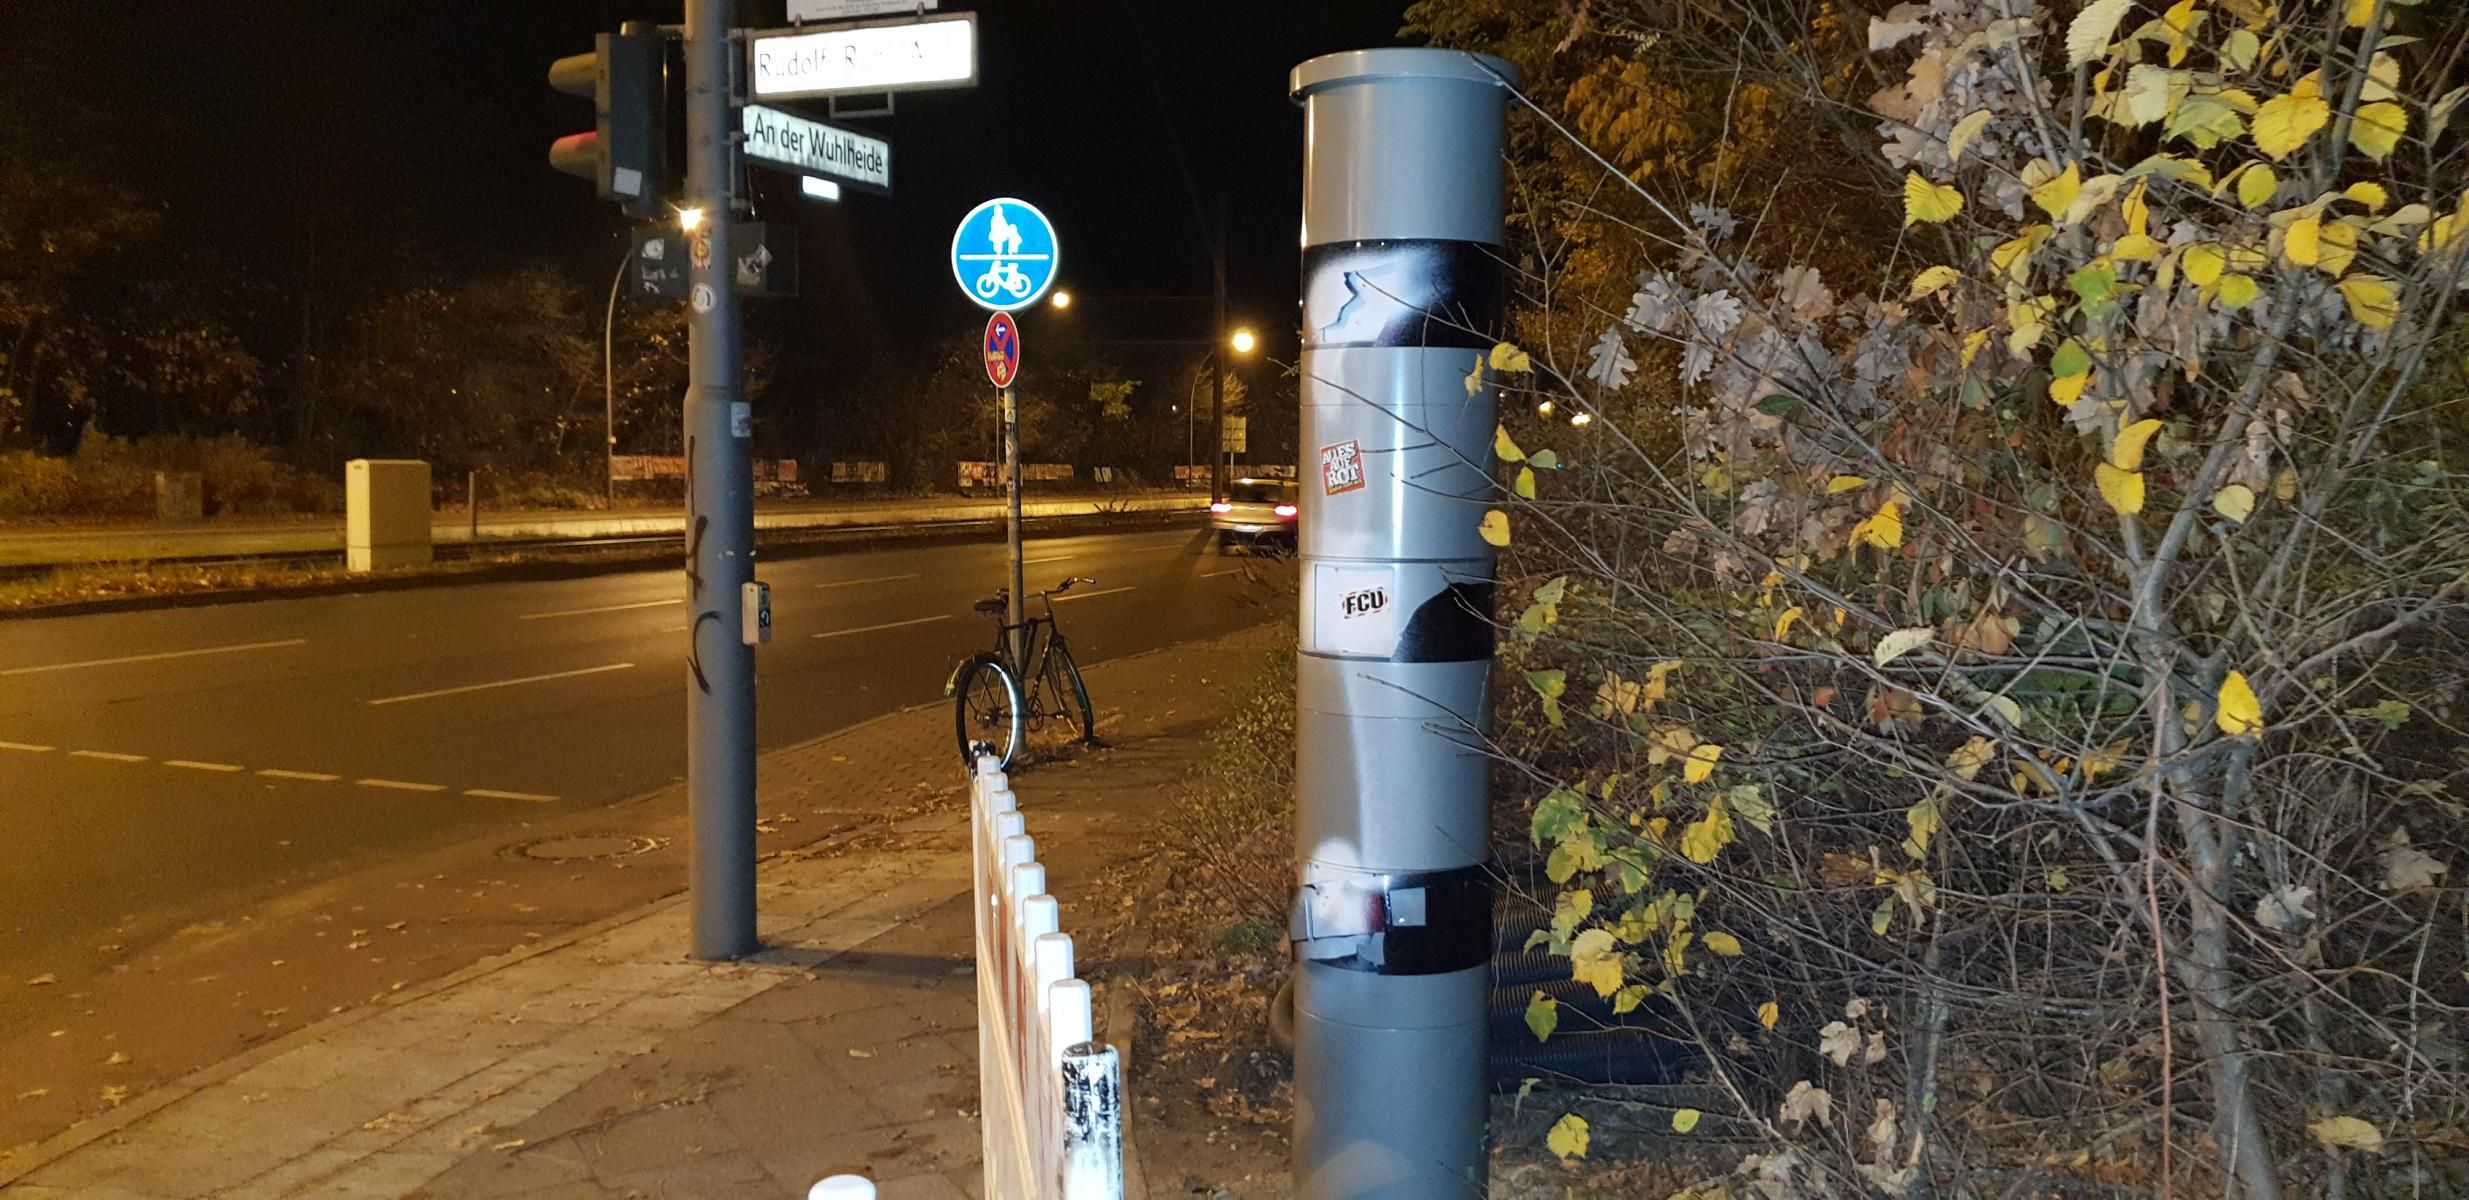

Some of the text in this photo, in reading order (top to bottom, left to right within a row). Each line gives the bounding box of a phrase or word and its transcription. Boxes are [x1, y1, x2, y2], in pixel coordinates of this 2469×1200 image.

[753, 113, 883, 174] An der Wuhlheide
[1322, 441, 1357, 465] ALLES
[1328, 463, 1360, 488] ROT
[1346, 590, 1384, 615] FCU
